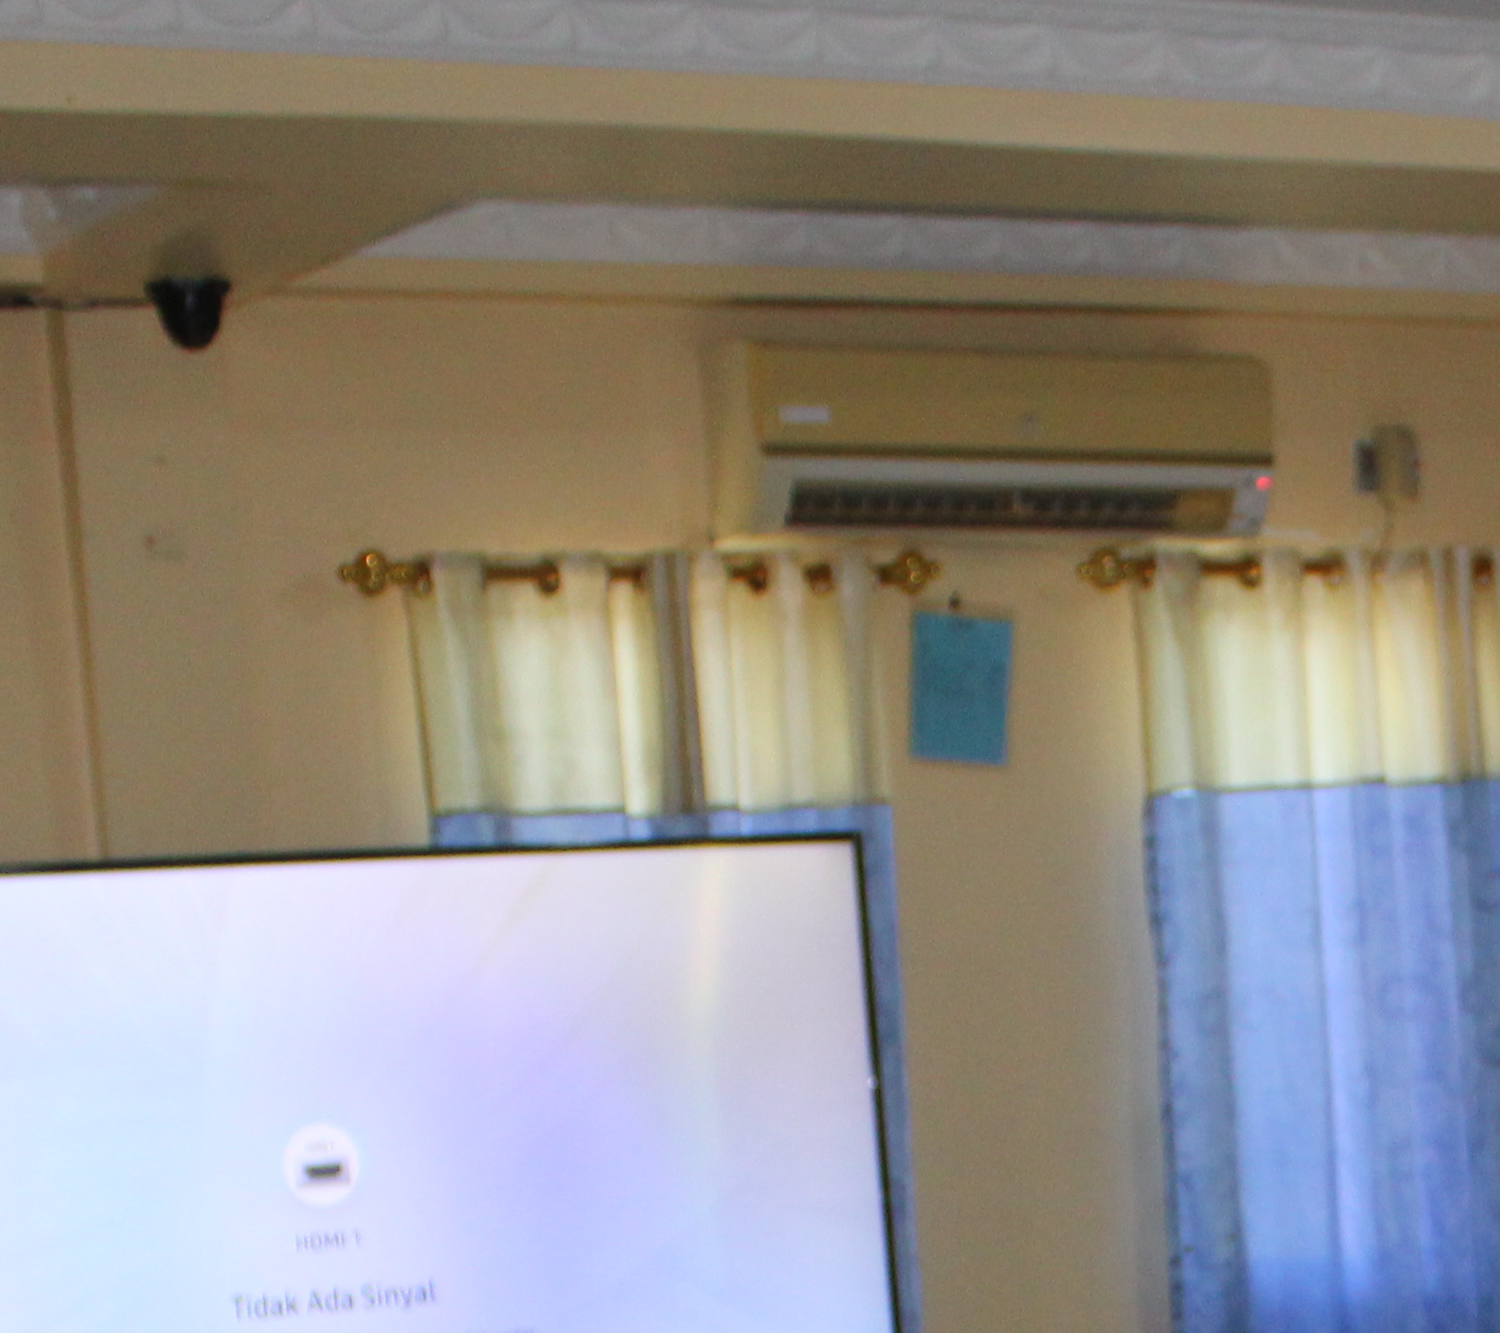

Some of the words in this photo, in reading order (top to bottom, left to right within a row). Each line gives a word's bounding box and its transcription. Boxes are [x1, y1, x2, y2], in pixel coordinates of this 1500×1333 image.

[295, 1231, 345, 1252] HDMI
[233, 1291, 299, 1322] Tidak
[308, 1286, 355, 1311] Ada
[361, 1276, 438, 1309] Sinyal
